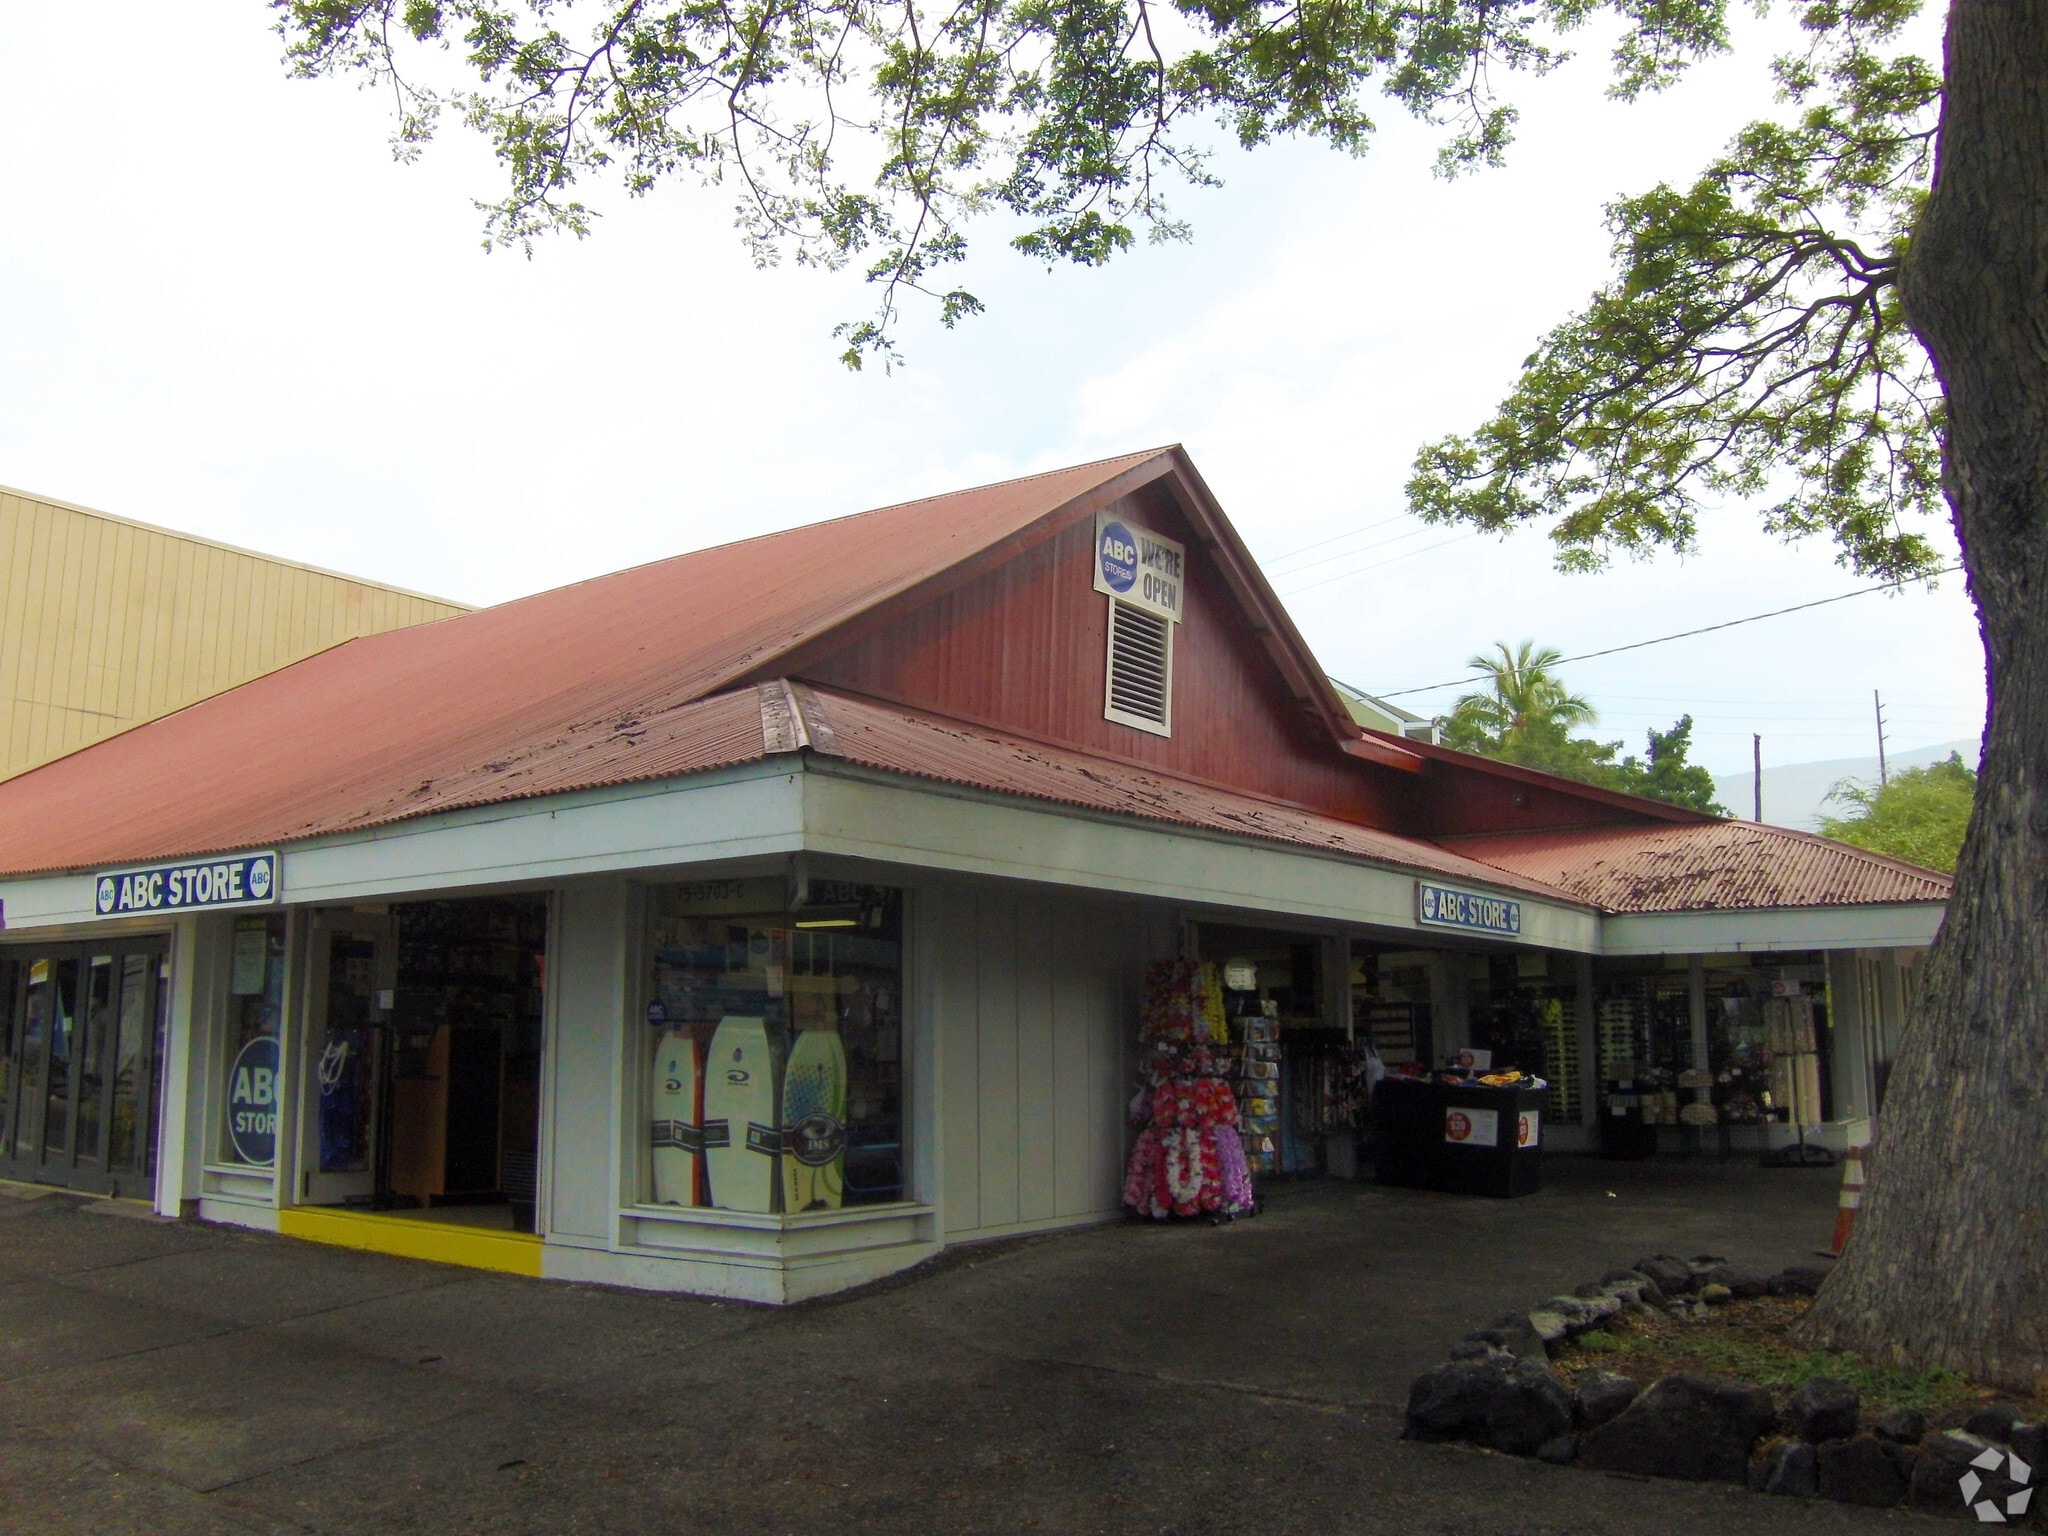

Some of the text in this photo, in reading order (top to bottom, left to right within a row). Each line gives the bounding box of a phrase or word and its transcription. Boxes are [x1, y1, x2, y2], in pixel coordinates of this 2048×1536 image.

[1102, 536, 1135, 566] ABC
[1140, 537, 1180, 580] WE'RE
[1104, 561, 1132, 581] STORES
[1143, 572, 1177, 611] OPEN
[118, 863, 244, 910] ABC STORE
[252, 872, 269, 885] ABC
[100, 889, 114, 901] ABC
[1437, 891, 1508, 929] ABC STORE
[1450, 1120, 1466, 1131] $20
